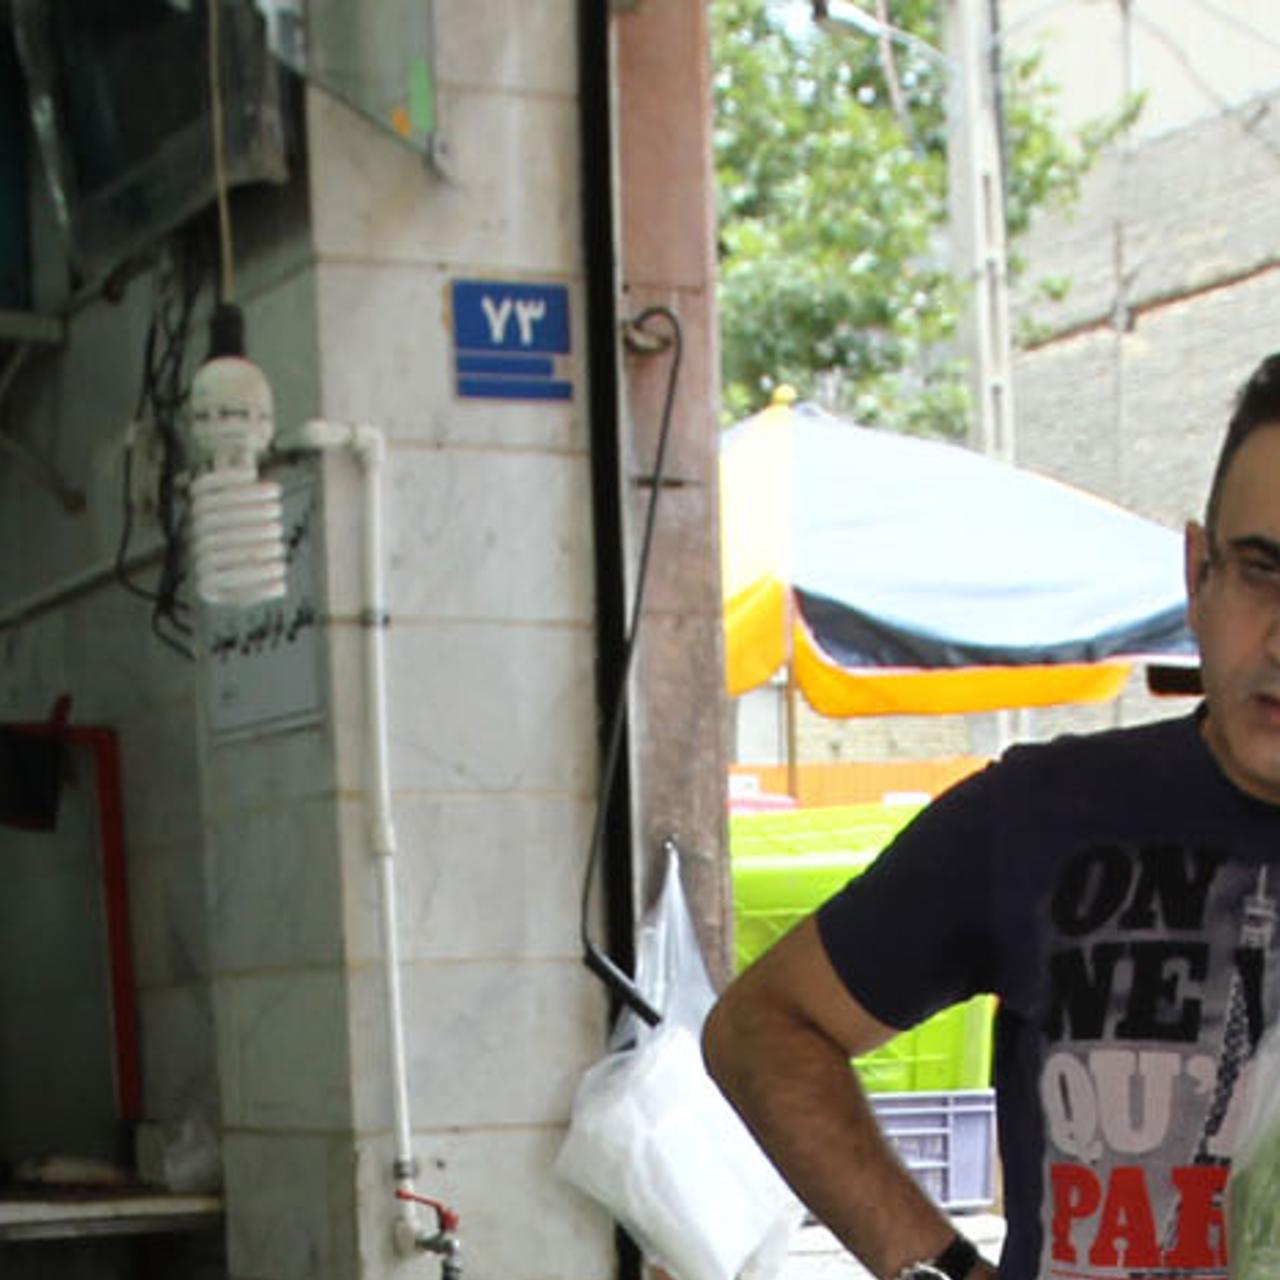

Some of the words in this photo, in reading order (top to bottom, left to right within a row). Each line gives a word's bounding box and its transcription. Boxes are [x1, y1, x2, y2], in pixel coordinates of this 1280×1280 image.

[481, 296, 547, 345] ۷۳
[1050, 846, 1222, 937] ON
[1046, 941, 1211, 1042] NE
